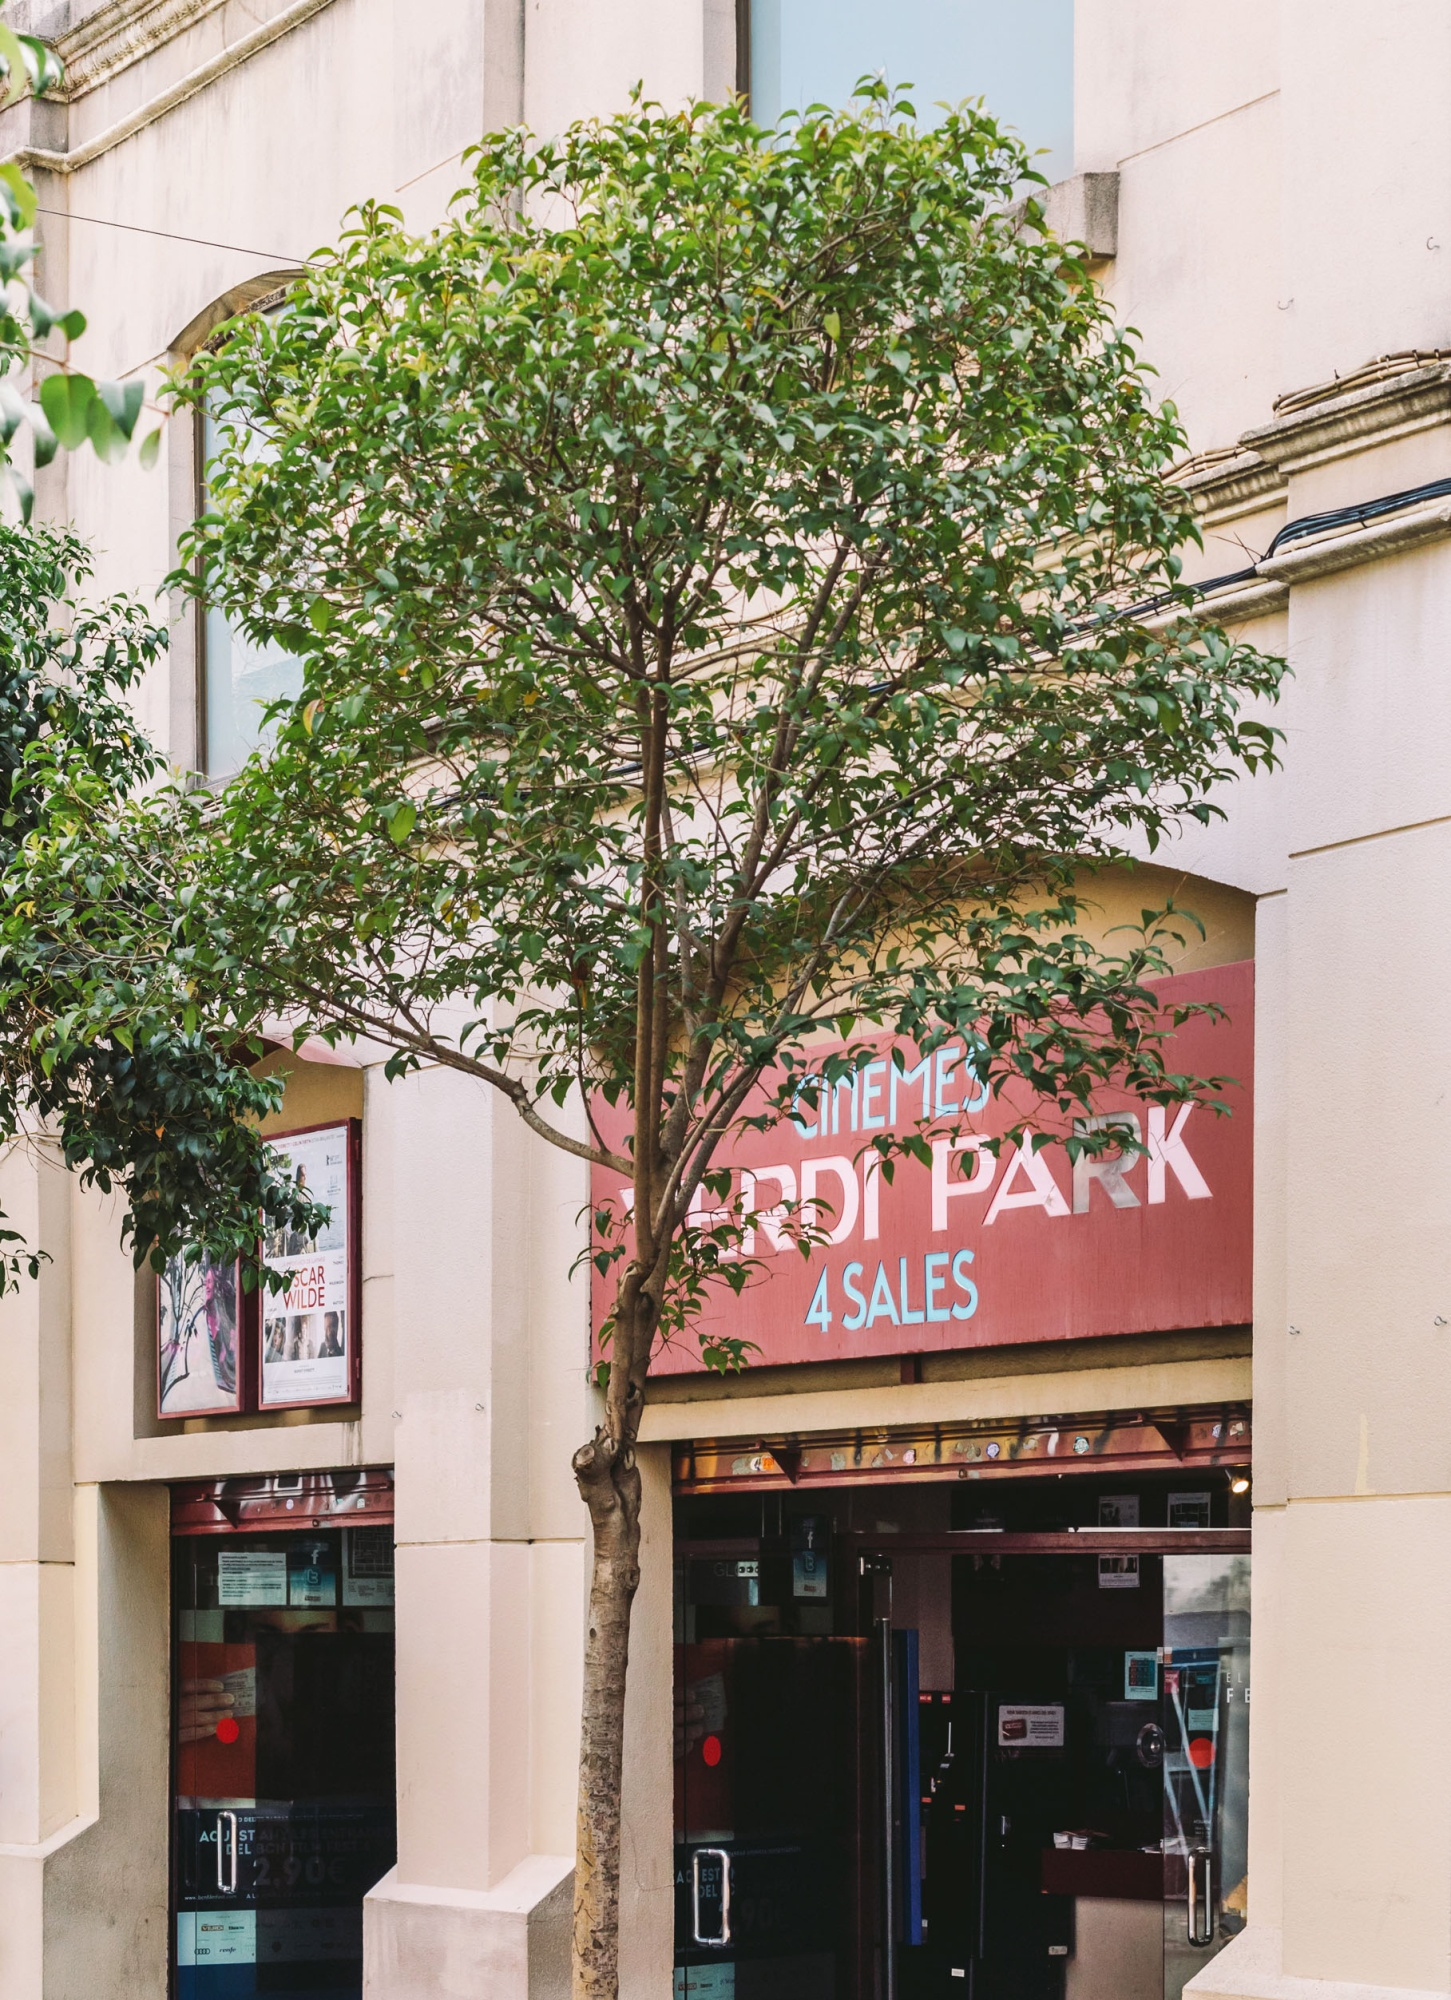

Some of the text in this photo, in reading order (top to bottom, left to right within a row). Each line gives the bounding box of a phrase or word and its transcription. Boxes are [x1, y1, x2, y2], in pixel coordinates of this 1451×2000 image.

[791, 1041, 990, 1140] CINEMES
[930, 1102, 1213, 1232] PARK
[283, 1286, 326, 1311] WILDE
[292, 1265, 326, 1288] SCAR
[804, 1248, 980, 1333] 4 SALES
